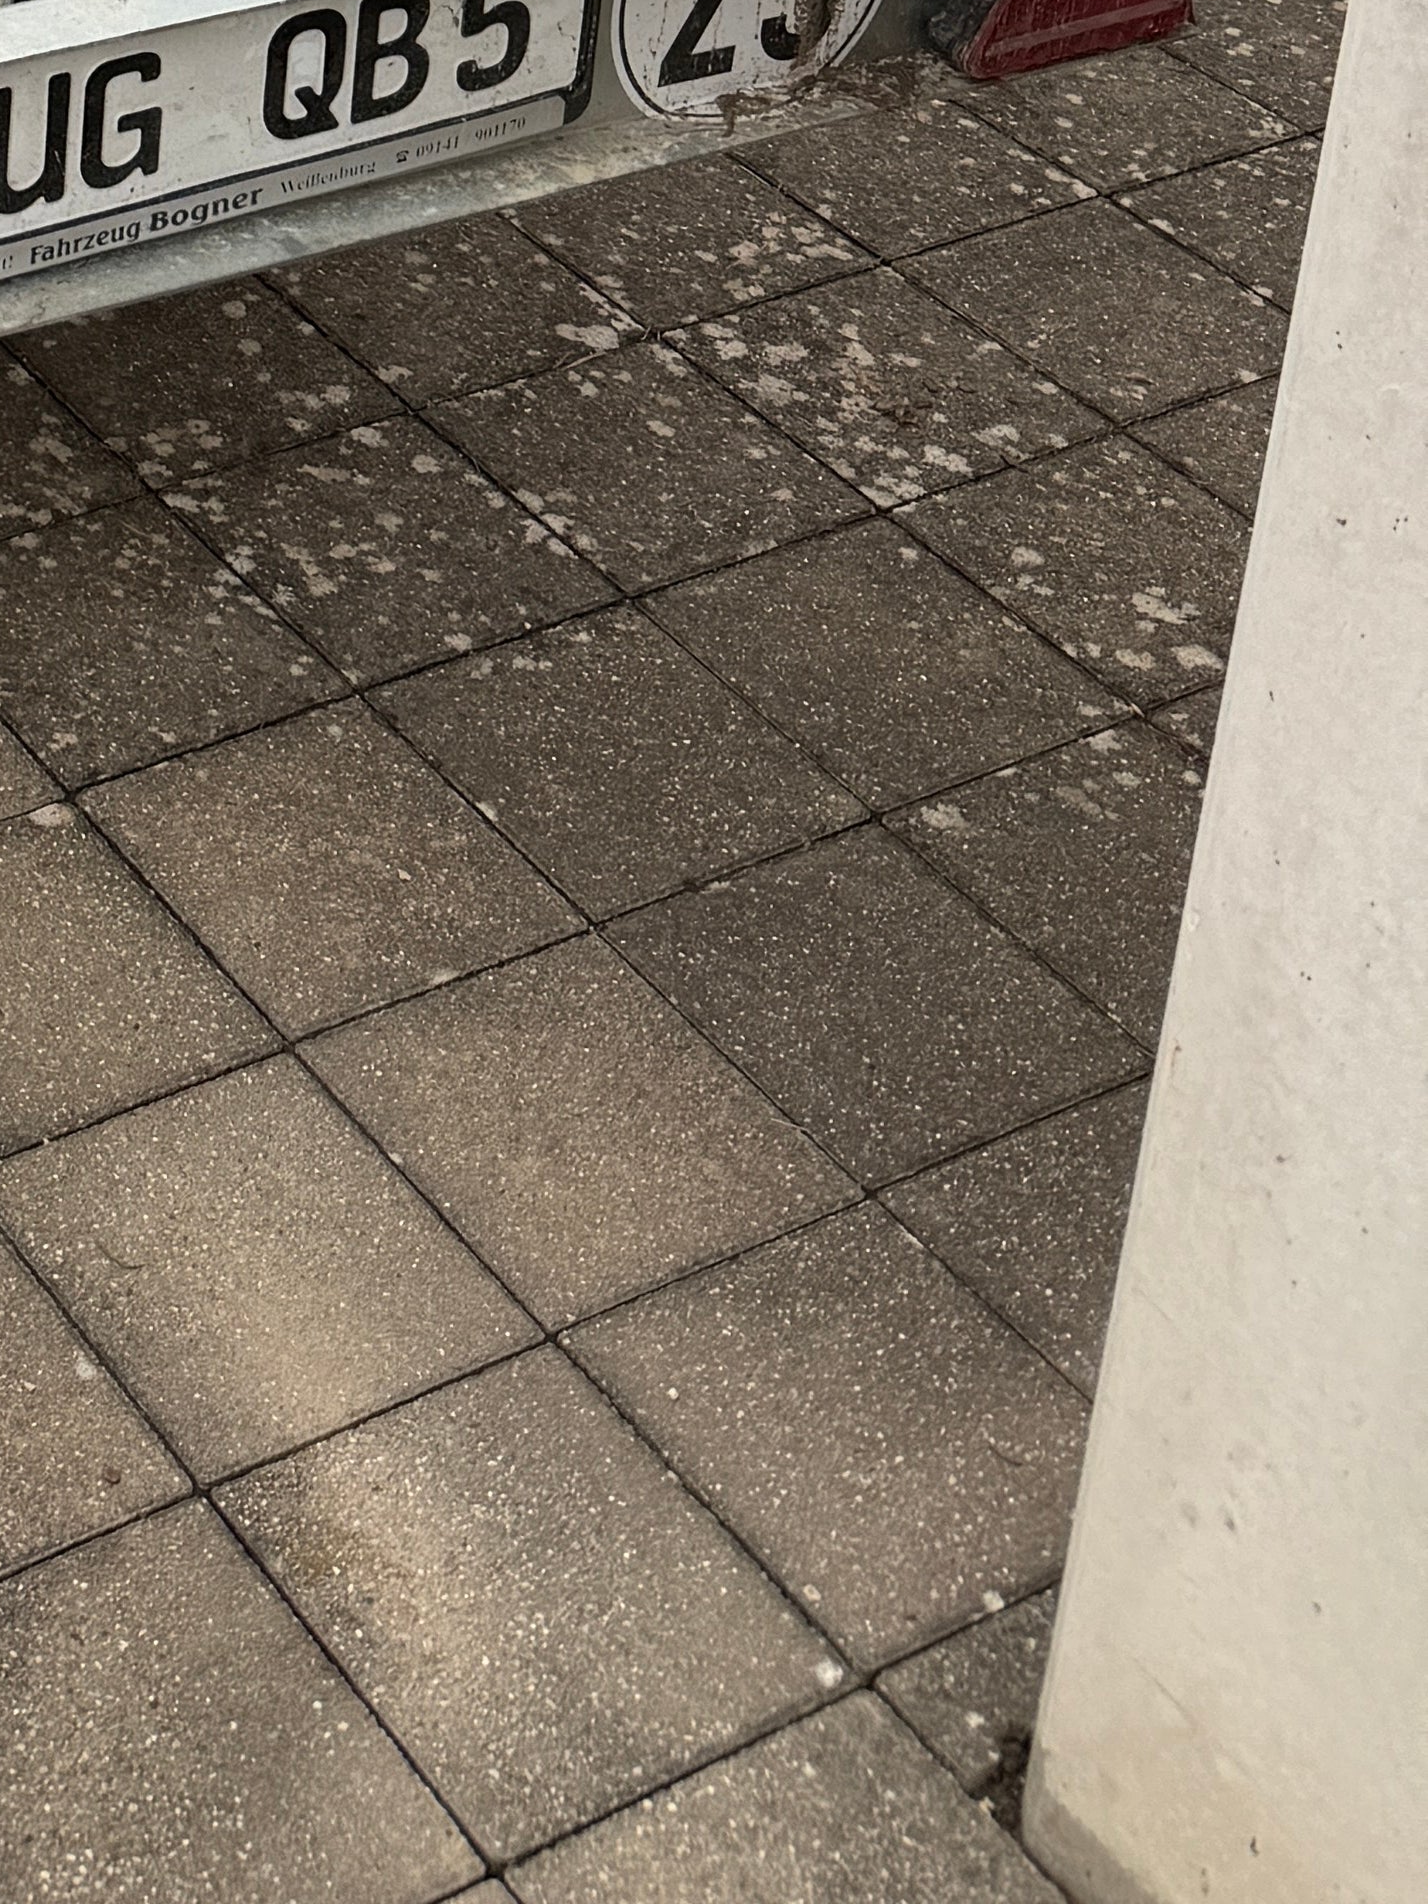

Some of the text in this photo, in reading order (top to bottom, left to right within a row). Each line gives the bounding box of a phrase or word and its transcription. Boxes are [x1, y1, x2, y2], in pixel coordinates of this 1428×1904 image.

[29, 220, 142, 266] Fahrzeug
[148, 187, 265, 233] Bogner
[279, 160, 378, 195] Weißenburg
[415, 135, 460, 159] 09141
[474, 115, 527, 142] 901170
